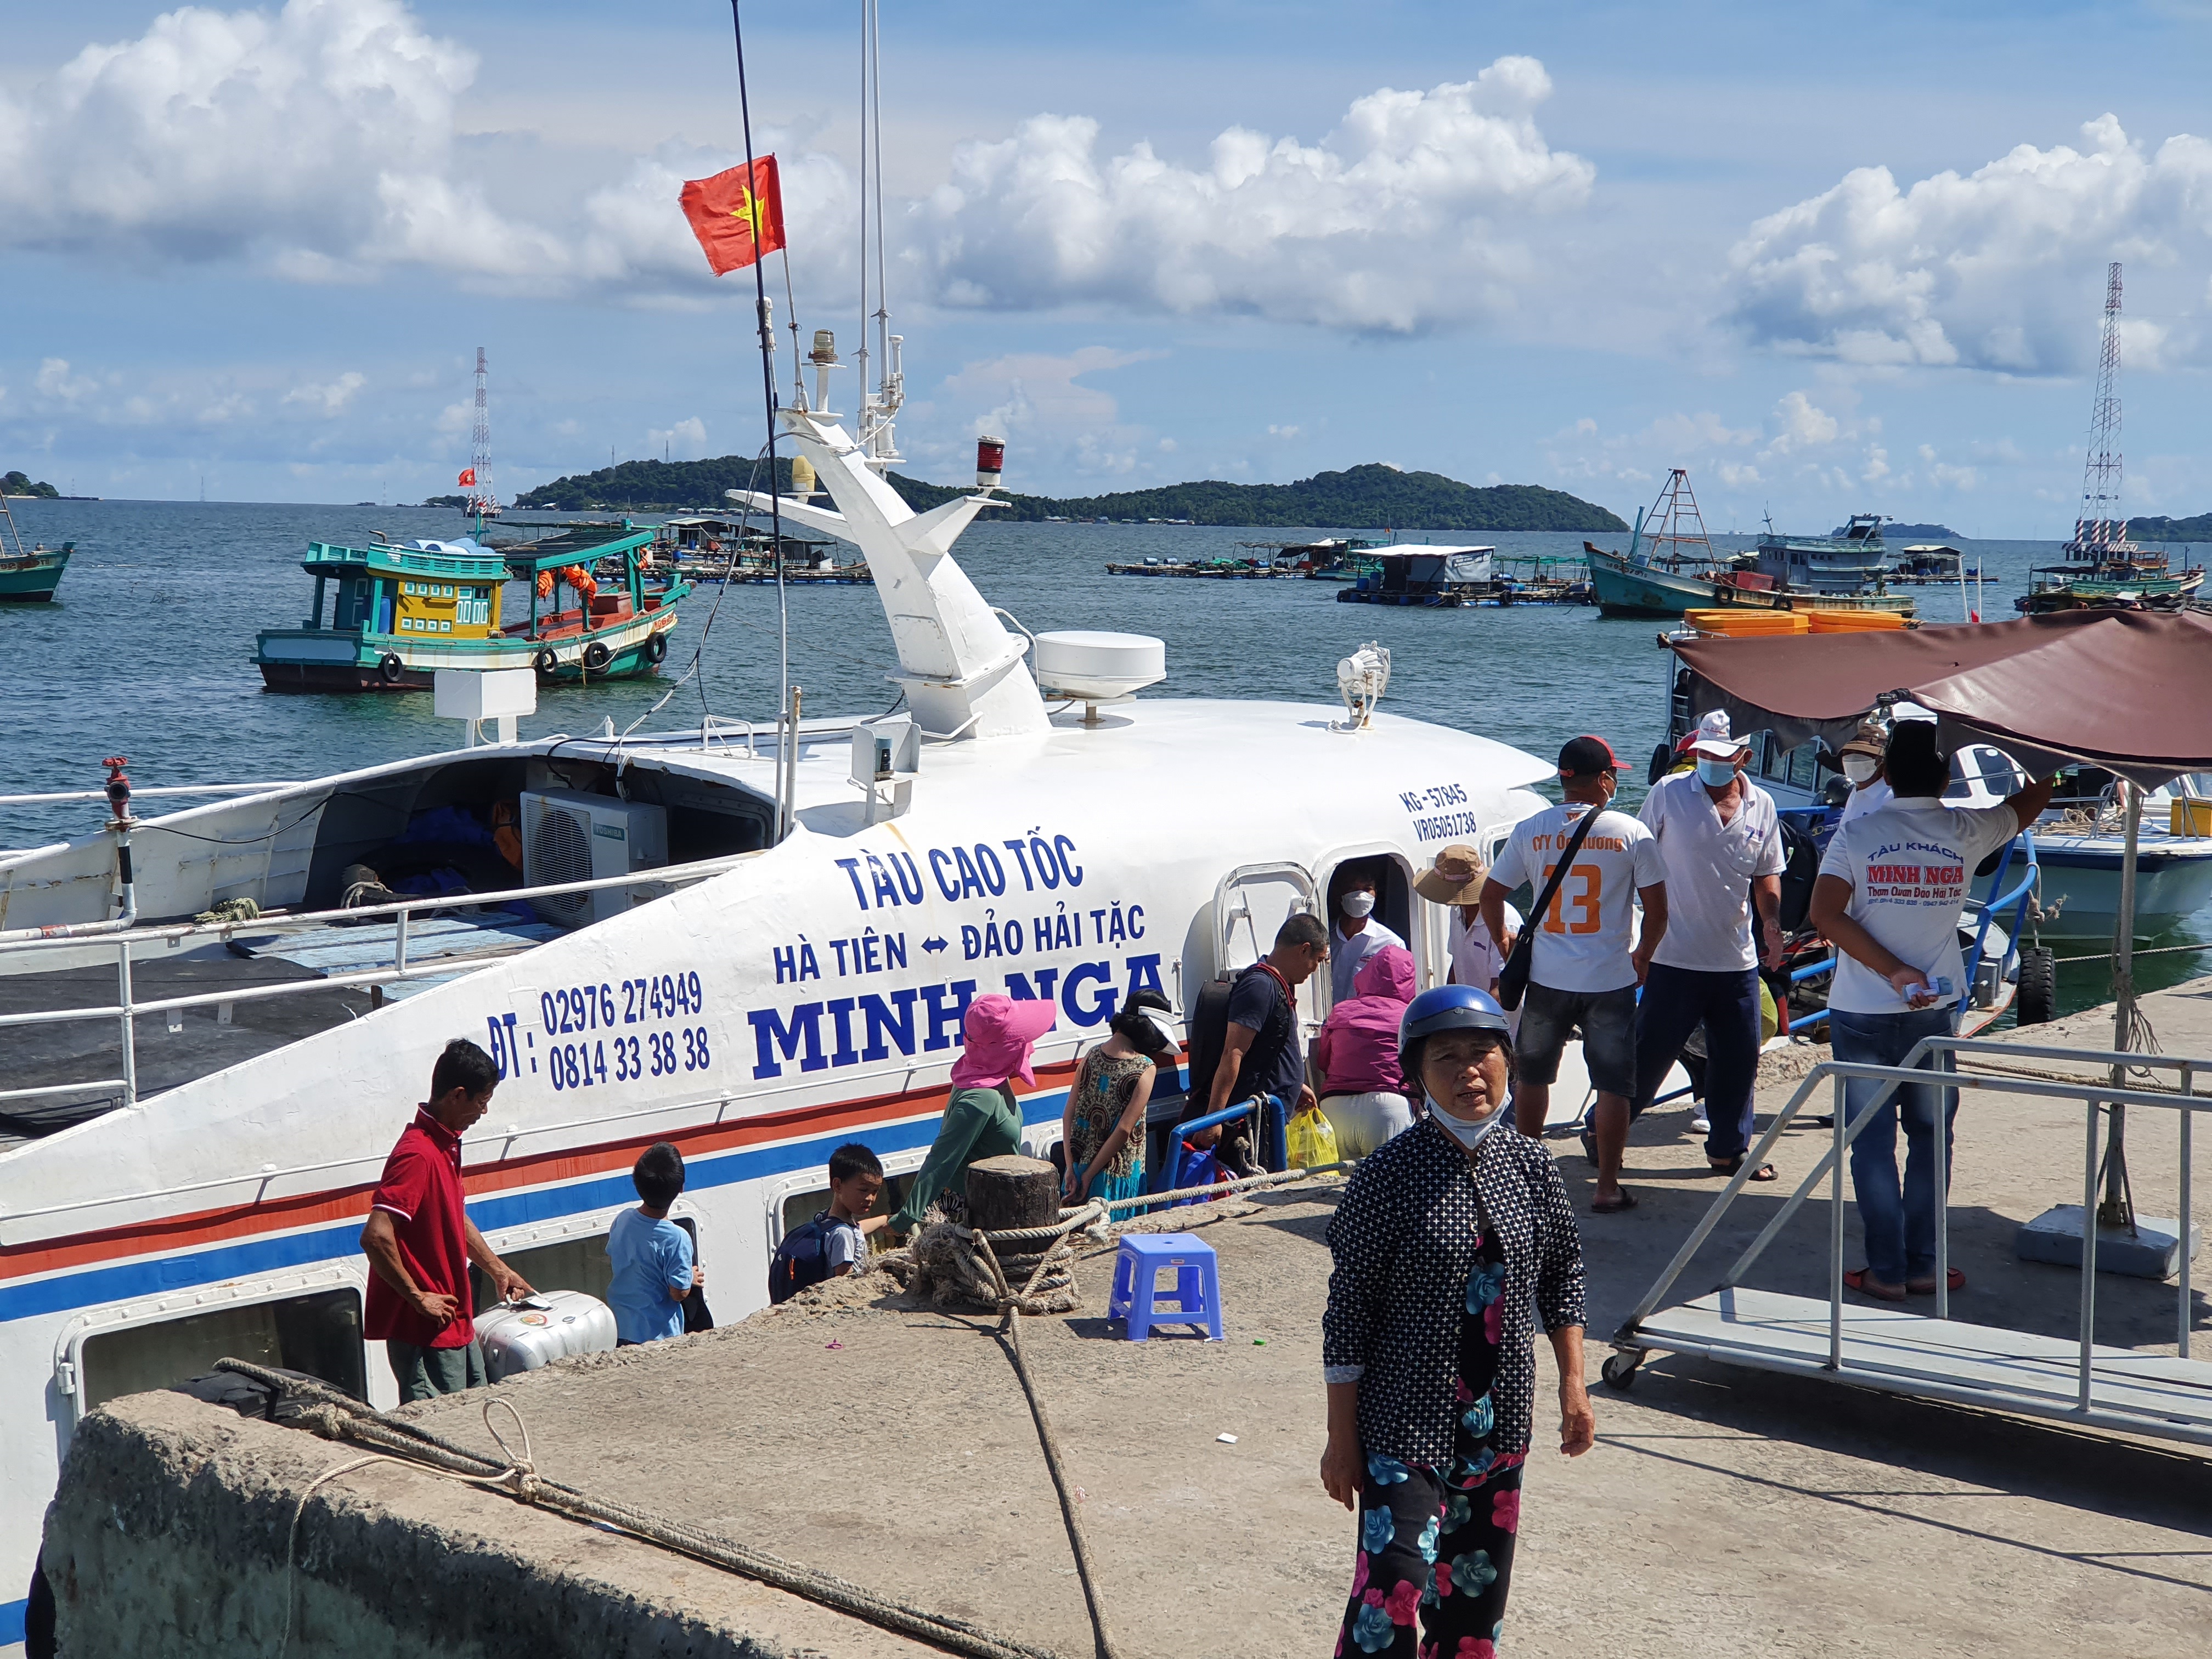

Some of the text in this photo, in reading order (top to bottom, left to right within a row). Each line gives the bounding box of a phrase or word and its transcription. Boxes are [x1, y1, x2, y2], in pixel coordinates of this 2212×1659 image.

[596, 825, 622, 838] TOSHIBA
[1413, 811, 1476, 842] VR05051738
[1867, 842, 1964, 865] TÀU KHÁCH
[833, 826, 1083, 911] TÀU CAO TỐC
[1542, 864, 1601, 934] 13
[1866, 865, 1964, 885] MINH NGA
[1867, 886, 1889, 896] Tham
[1891, 886, 1912, 897] Quan
[773, 900, 1145, 984] HÀ TIÊN ĐẢO HẢI TẶC
[541, 971, 702, 1036] 02976 274949
[747, 979, 977, 1080] MINH
[550, 1026, 710, 1091] 0814 33 38 38
